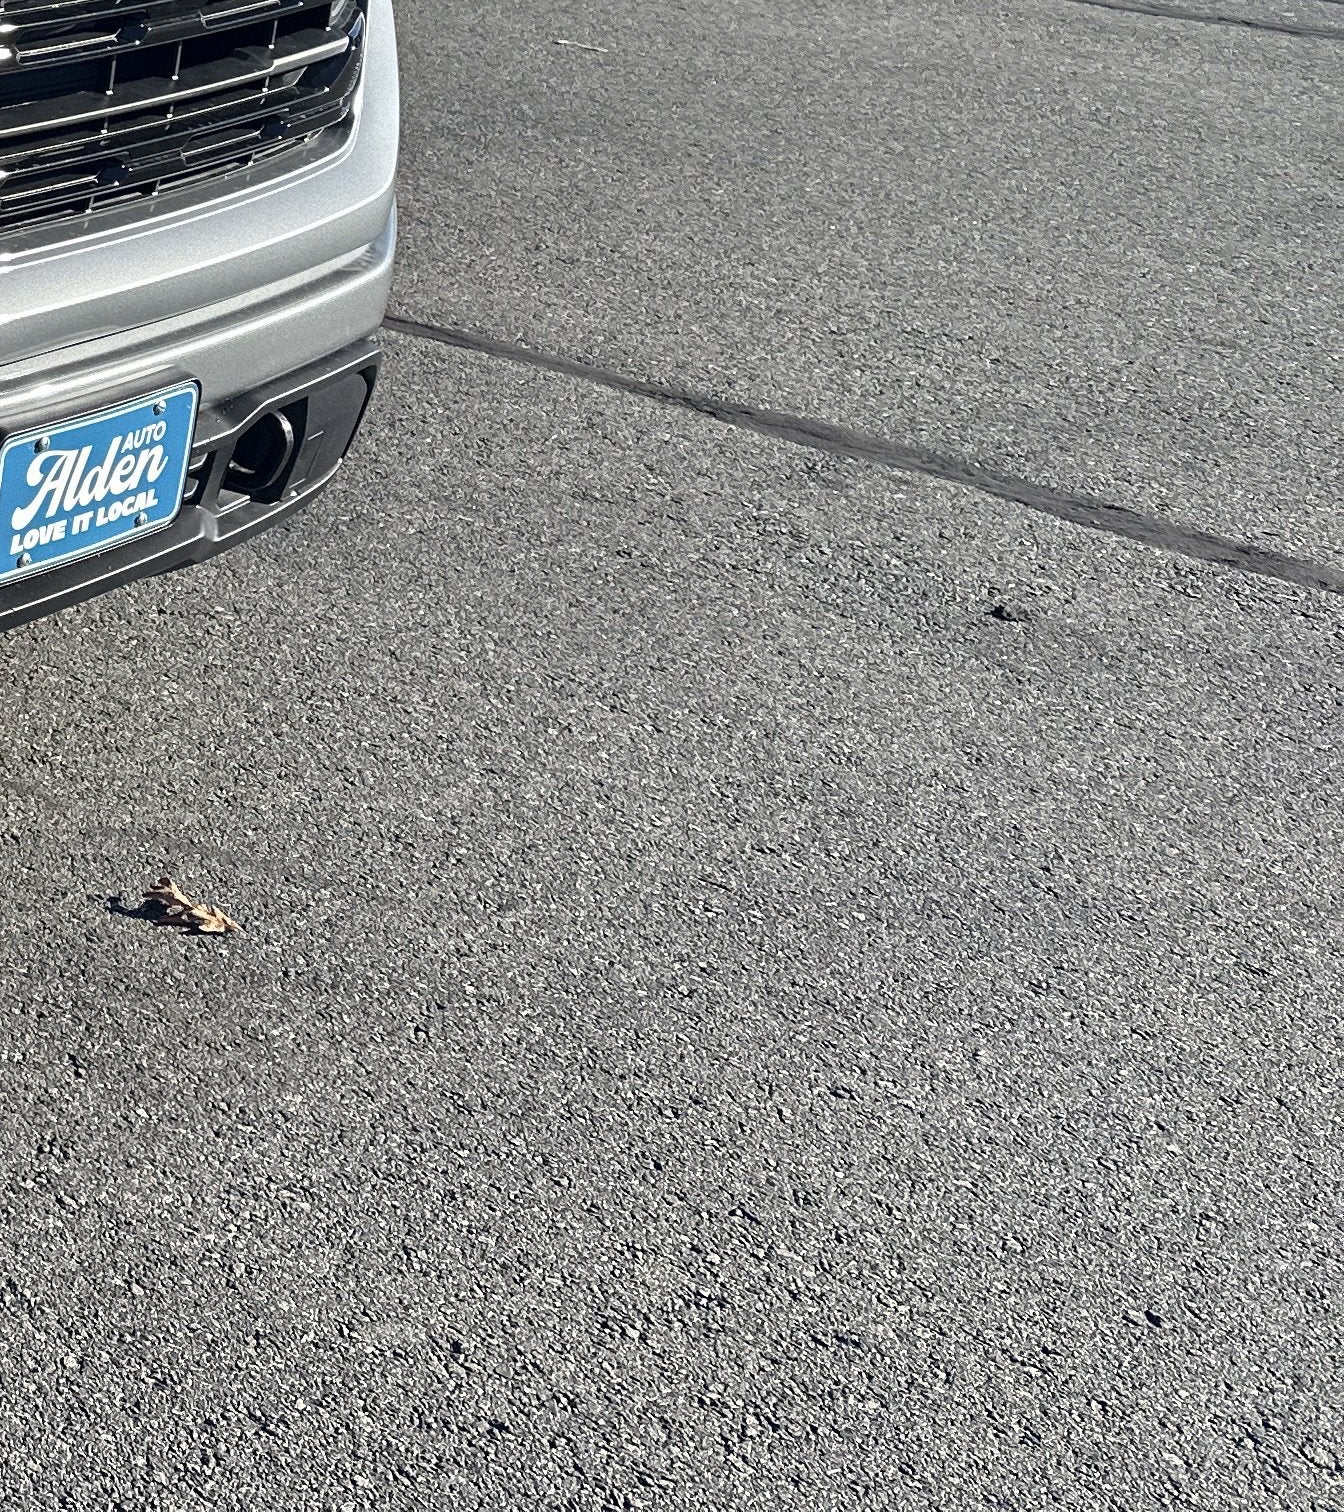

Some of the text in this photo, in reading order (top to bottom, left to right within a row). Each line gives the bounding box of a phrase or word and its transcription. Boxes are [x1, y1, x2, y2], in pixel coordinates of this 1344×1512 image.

[121, 420, 167, 454] AUTO
[10, 435, 170, 531] Alden
[9, 488, 159, 555] LOVE IT LOCAL
